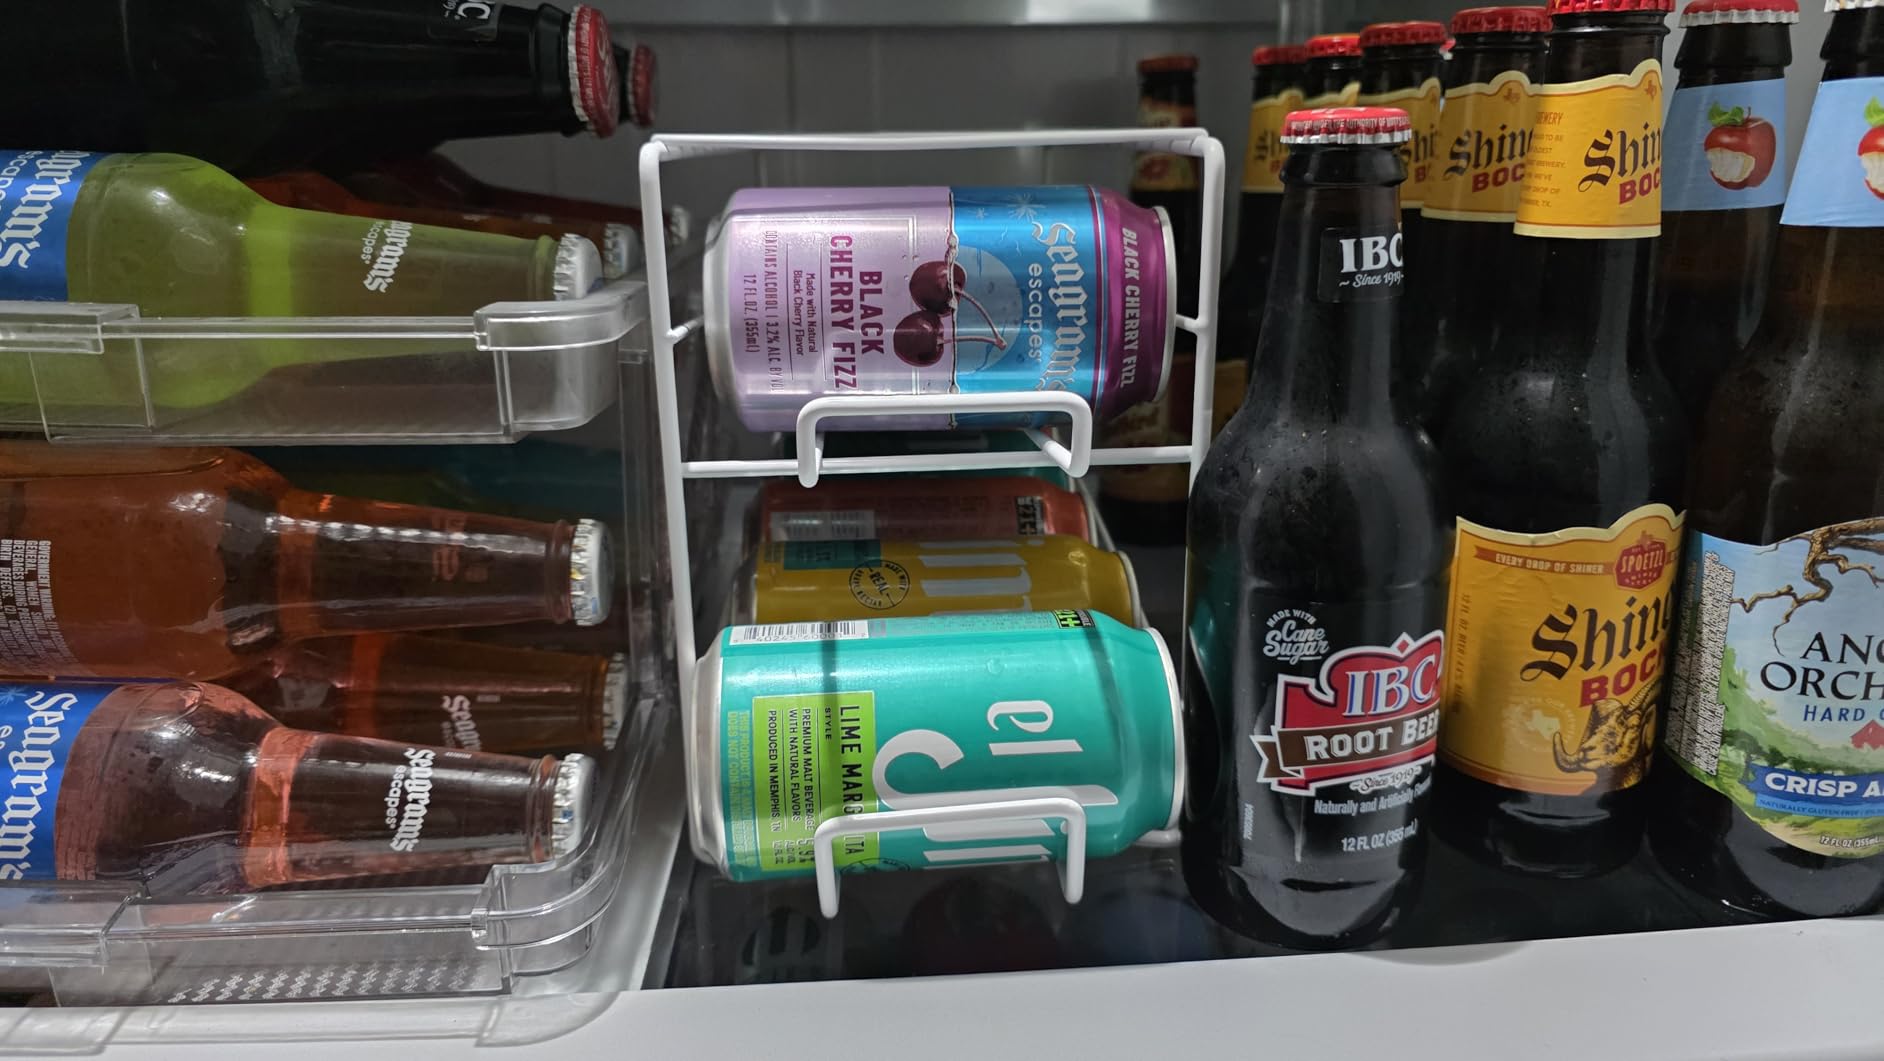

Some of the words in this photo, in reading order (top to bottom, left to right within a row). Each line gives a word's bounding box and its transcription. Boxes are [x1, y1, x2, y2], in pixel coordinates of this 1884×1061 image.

[765, 230, 778, 268] CONTAINS
[1122, 227, 1140, 281] BLACK
[1340, 232, 1403, 273] IBC
[744, 274, 756, 283] 12
[765, 271, 778, 311] ALCOHOL
[793, 270, 803, 293] Black
[806, 273, 815, 296] Made
[830, 235, 854, 331] CHERRY
[1352, 274, 1382, 288] Since
[1383, 271, 1401, 287] 1919
[792, 297, 803, 327] Cherry
[807, 299, 816, 318] with
[859, 271, 884, 355] BLACK
[1024, 263, 1043, 360] escapes
[1124, 285, 1141, 351] CHERRY
[766, 322, 779, 343] 3.2%
[795, 329, 804, 356] Flavor
[808, 321, 818, 352] Natural
[833, 342, 856, 389] FIZZ
[1120, 355, 1137, 389] FIZZ
[26, 540, 37, 574] GENERAL,
[38, 540, 51, 587] GOVERNMENT
[1495, 552, 1523, 567] EVERY
[1526, 559, 1550, 571] DROP
[1554, 561, 1566, 572] OF
[1570, 563, 1604, 575] SHINER
[1621, 549, 1664, 574] SPOETZL
[14, 581, 26, 606] DURING
[26, 581, 40, 606] WOMEN
[1266, 609, 1291, 628] MADE
[1292, 609, 1317, 625] WITH
[1282, 619, 1326, 642] Cane
[1263, 629, 1330, 665] Sugar
[1342, 654, 1436, 717] IBC
[789, 709, 798, 733] WITH
[987, 700, 1083, 756] el
[1804, 704, 1865, 722] HARD
[768, 711, 779, 760] PRODUCED
[802, 708, 812, 754] PREMIUM
[840, 706, 862, 754] LIME
[1303, 726, 1394, 761] ROOT
[770, 763, 779, 773] IN
[789, 737, 800, 780] NATURAL
[803, 758, 812, 782] MALT
[384, 765, 407, 829] escapes
[390, 747, 436, 852] Seagram's
[1361, 777, 1389, 791] Since
[1765, 773, 1858, 798] CRISP
[791, 783, 801, 821] FLAVORS
[804, 786, 815, 830] BEVERAGE
[841, 764, 864, 855] MARGITA
[1314, 799, 1358, 817] Naturally
[1360, 797, 1377, 813] and
[1760, 799, 1806, 813] NATURALLY
[1808, 807, 1839, 815] GLUTEN
[771, 822, 780, 832] TN
[1341, 837, 1356, 852] 12
[1357, 836, 1370, 851] FL
[1371, 832, 1386, 849] OZ
